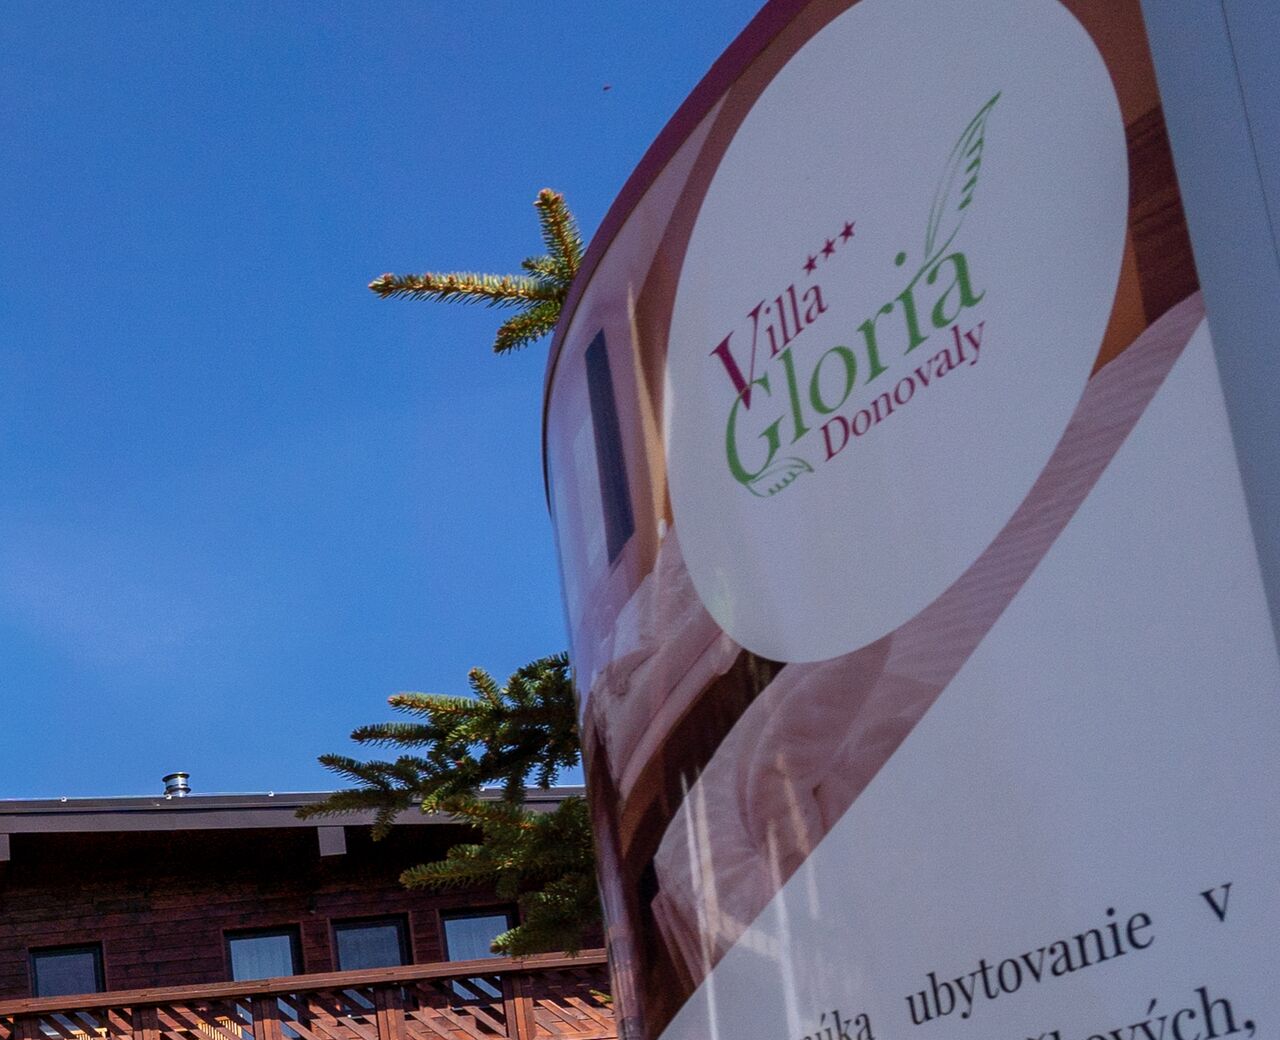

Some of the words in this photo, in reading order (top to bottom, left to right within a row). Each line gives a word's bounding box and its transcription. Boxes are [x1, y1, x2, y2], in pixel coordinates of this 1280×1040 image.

[709, 280, 829, 409] Villa
[724, 250, 986, 485] Gloria
[820, 320, 986, 462] Donovaly
[906, 907, 1156, 1026] ubytovanie
[1200, 882, 1235, 924] v
